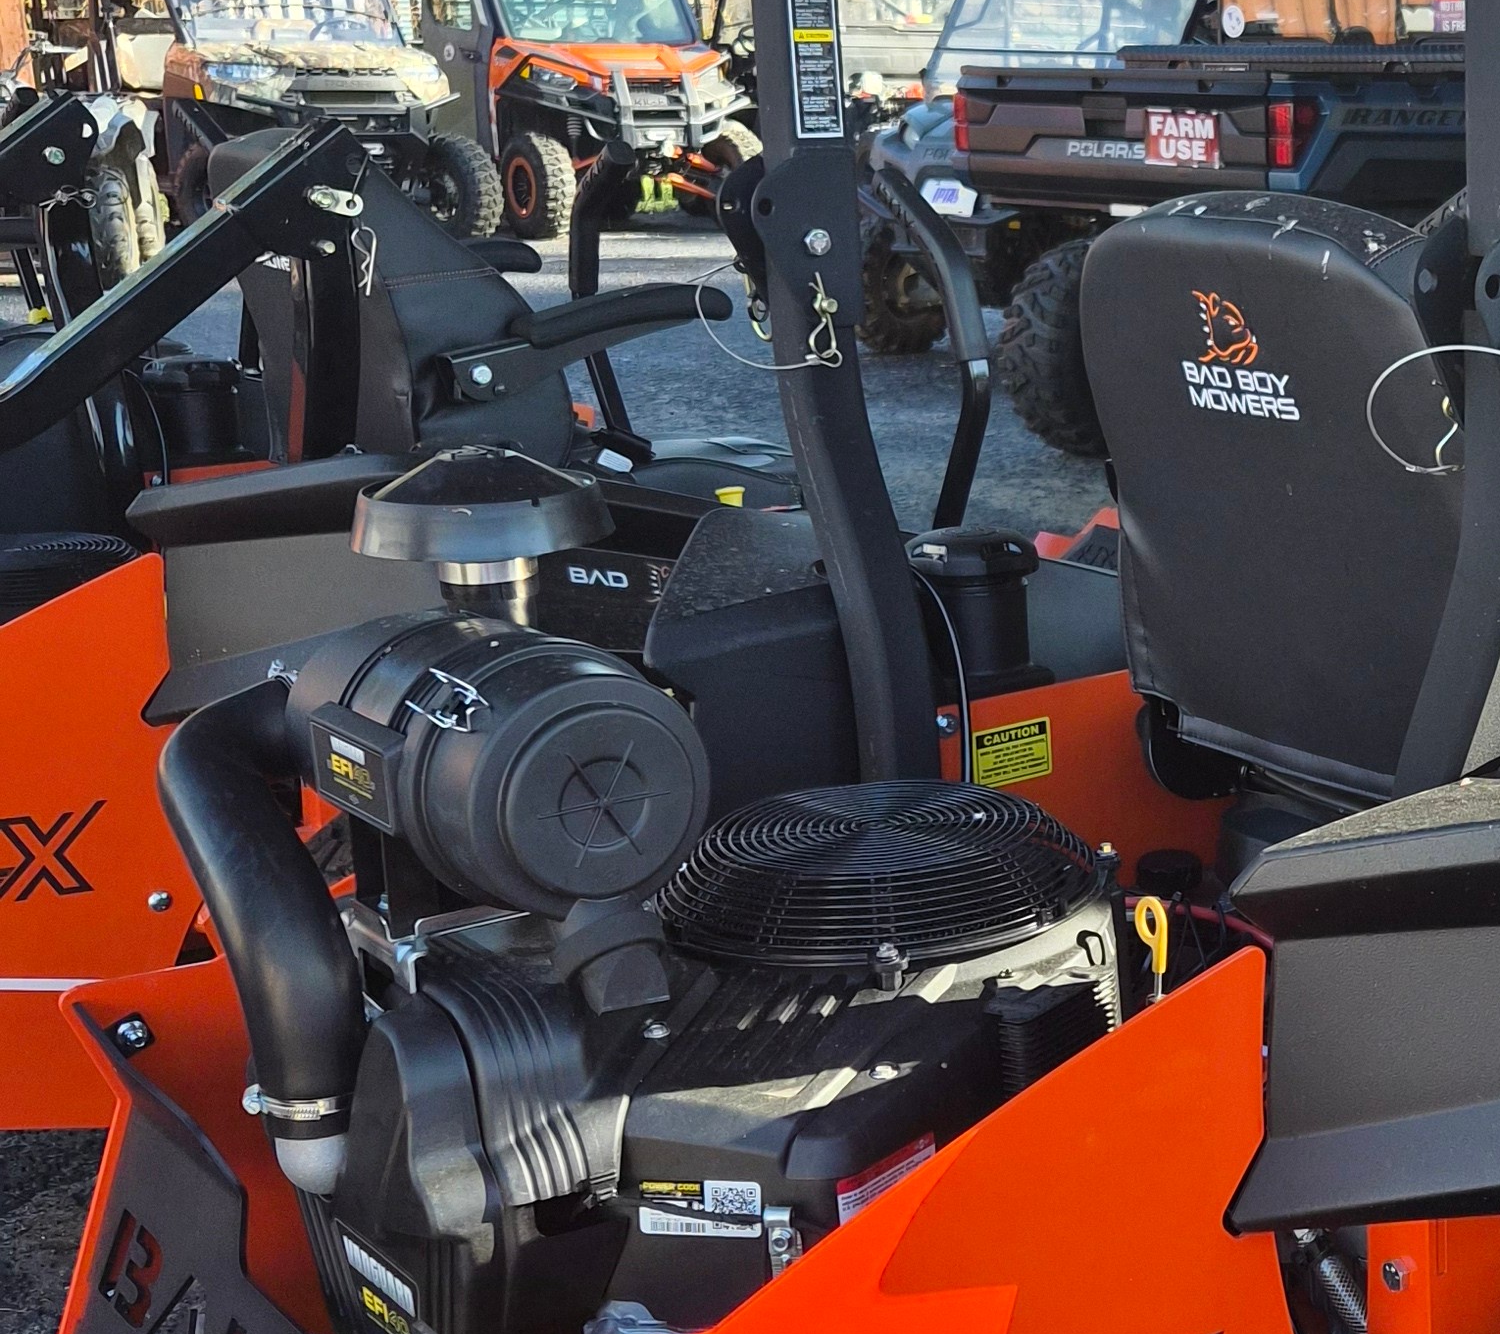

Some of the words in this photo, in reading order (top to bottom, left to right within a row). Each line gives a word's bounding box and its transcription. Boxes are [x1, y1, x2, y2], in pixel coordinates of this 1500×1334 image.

[1149, 115, 1215, 140] FARM
[1066, 141, 1146, 160] POLARIS
[1159, 138, 1207, 162] USE
[1182, 360, 1233, 389] BAD
[1235, 368, 1290, 397] BOY
[1188, 384, 1300, 421] MOWERS
[567, 565, 630, 589] BAD
[983, 724, 1040, 746] CAUTION
[361, 1285, 390, 1324] EFI
